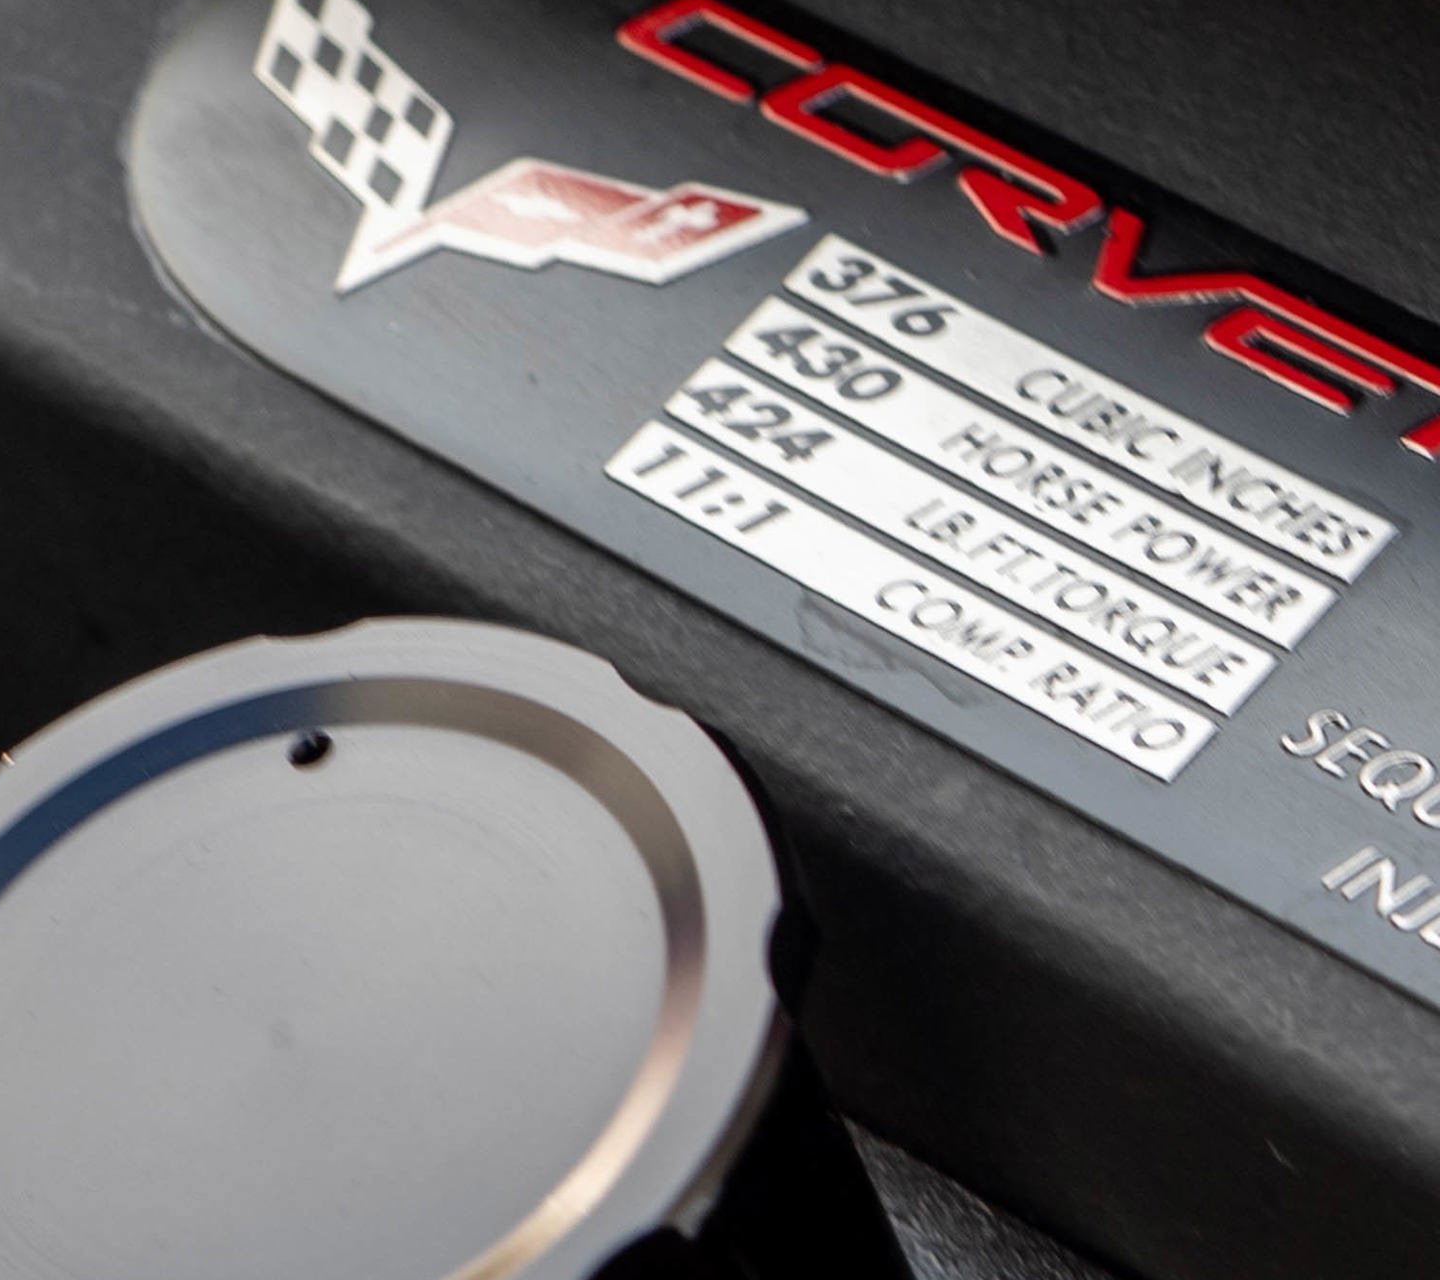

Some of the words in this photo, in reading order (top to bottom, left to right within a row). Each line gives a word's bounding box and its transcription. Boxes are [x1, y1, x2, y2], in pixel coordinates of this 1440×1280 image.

[694, 382, 834, 465] 424
[759, 320, 902, 403] 430
[940, 422, 1125, 526] HORSE
[1112, 517, 1303, 626] POWER
[810, 253, 955, 338] 376
[1016, 367, 1179, 463] CUBIC
[1166, 449, 1372, 563] INCHES
[634, 442, 791, 533] 11:1
[874, 577, 1033, 673] COMP.
[1029, 658, 1186, 754] RATIO
